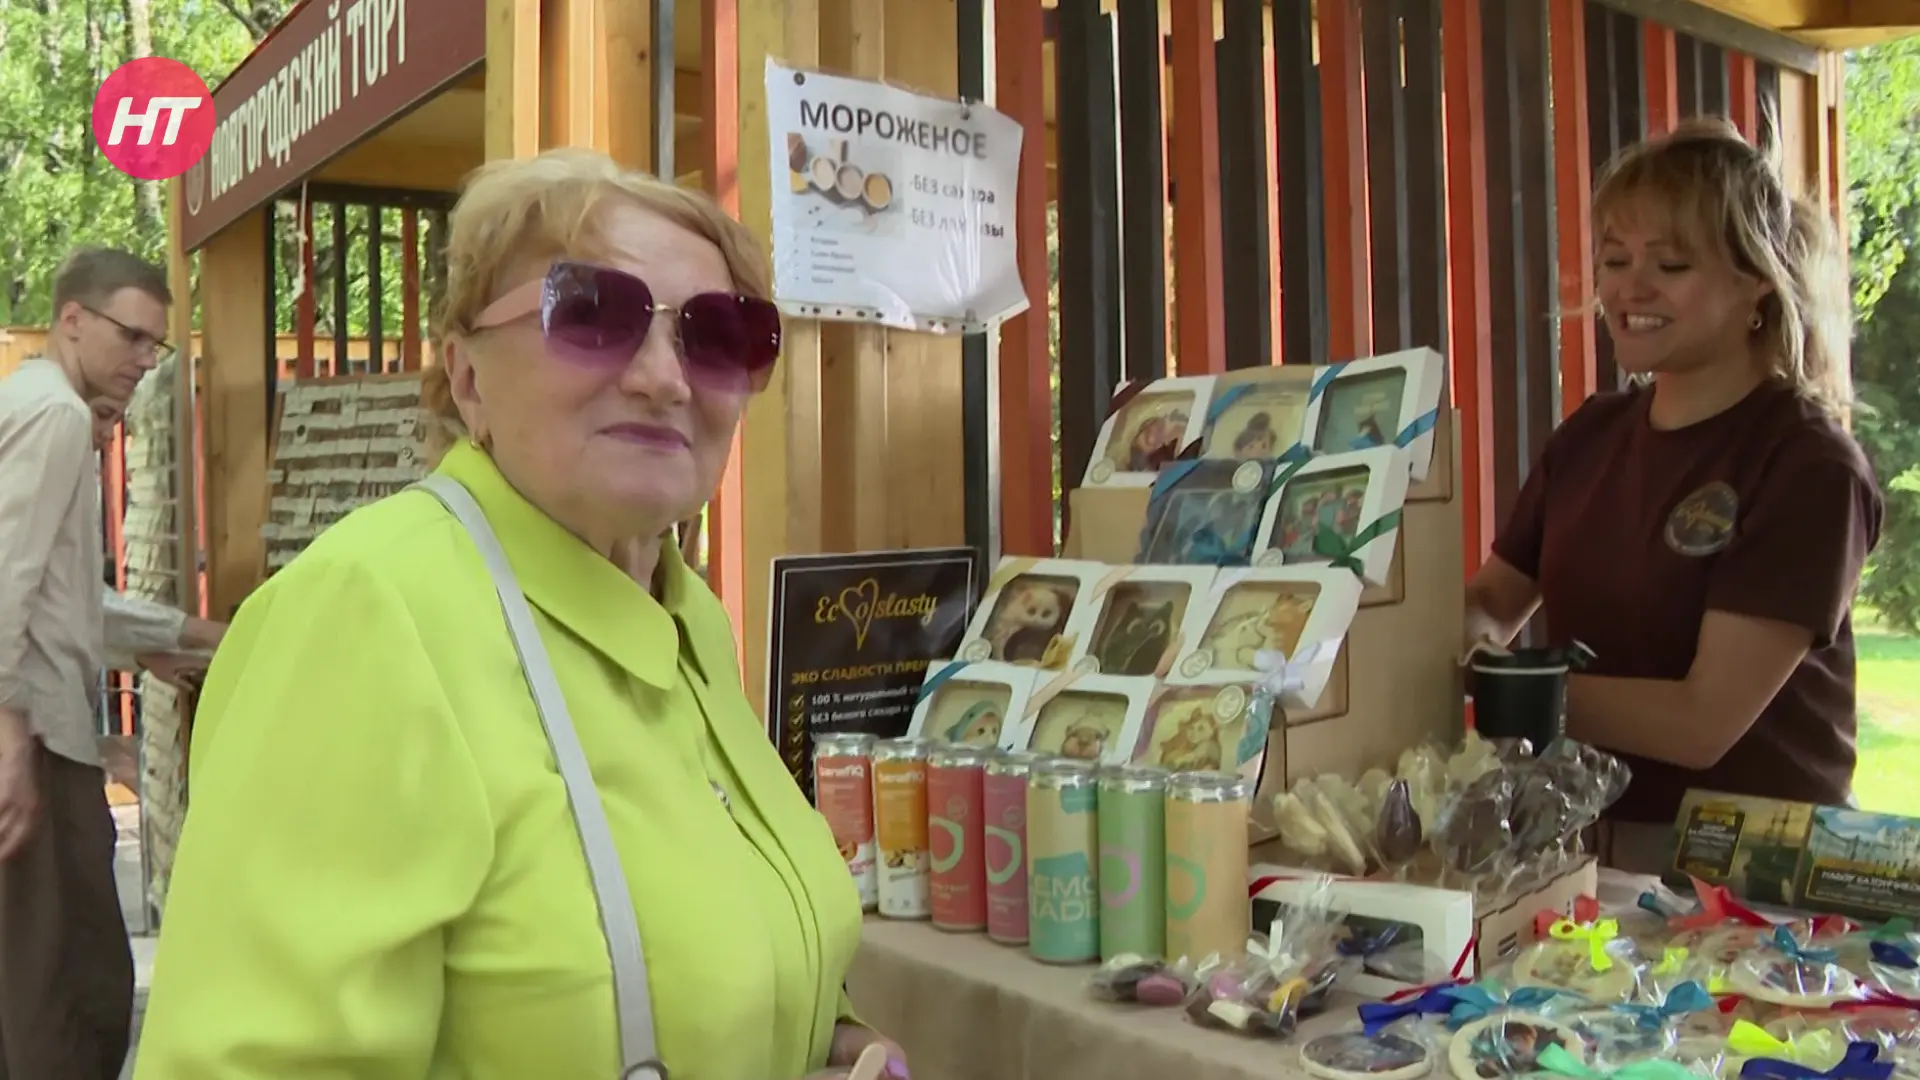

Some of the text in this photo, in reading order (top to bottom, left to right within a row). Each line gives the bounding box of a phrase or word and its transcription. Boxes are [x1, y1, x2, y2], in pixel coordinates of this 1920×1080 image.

[211, 0, 341, 201] НОВГОРОДСКИЙ
[800, 98, 987, 159] МОРОЖЕНОЕ
[942, 184, 995, 204] сара
[791, 671, 819, 685] ЭКО
[821, 662, 892, 680] СЛАДОСТИ
[812, 693, 831, 706] 100
